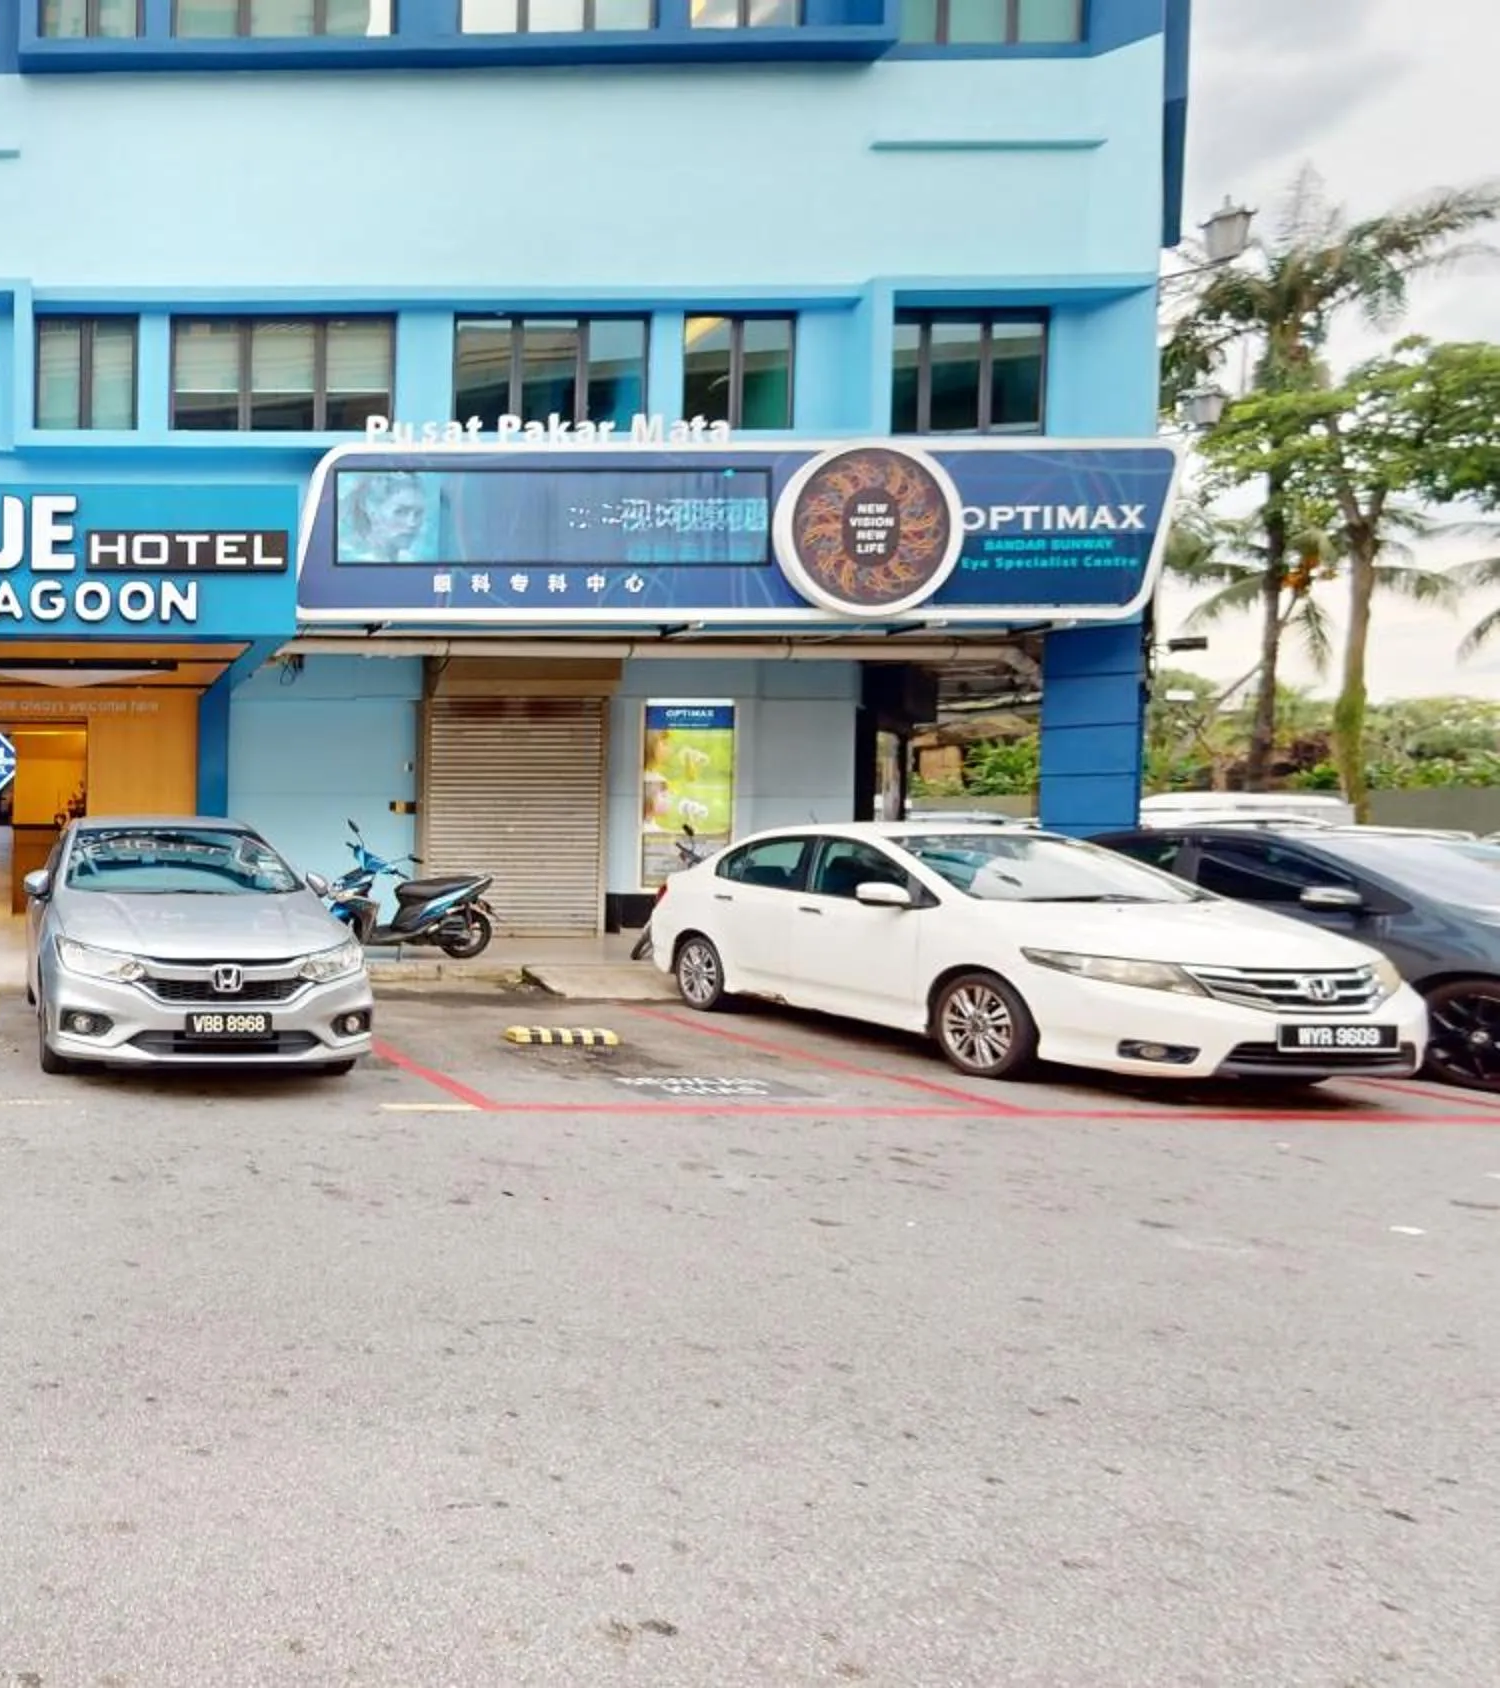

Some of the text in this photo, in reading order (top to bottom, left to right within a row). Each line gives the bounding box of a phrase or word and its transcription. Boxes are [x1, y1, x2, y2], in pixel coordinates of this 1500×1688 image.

[364, 411, 734, 447] Pusat Pakar Mata
[856, 502, 889, 515] NEW
[849, 516, 895, 528] VISION
[961, 504, 1147, 531] OPTIMAX
[856, 529, 888, 541] NEW
[89, 533, 285, 566] HOTEL
[856, 542, 887, 554] LIFE
[984, 537, 1115, 552] BANDAR SUNWAY
[961, 555, 1140, 571] Eye Specialist Centre
[432, 573, 645, 595] 眼科专科中心
[192, 1014, 266, 1033] VBB 8968
[1297, 1027, 1333, 1045] WYR
